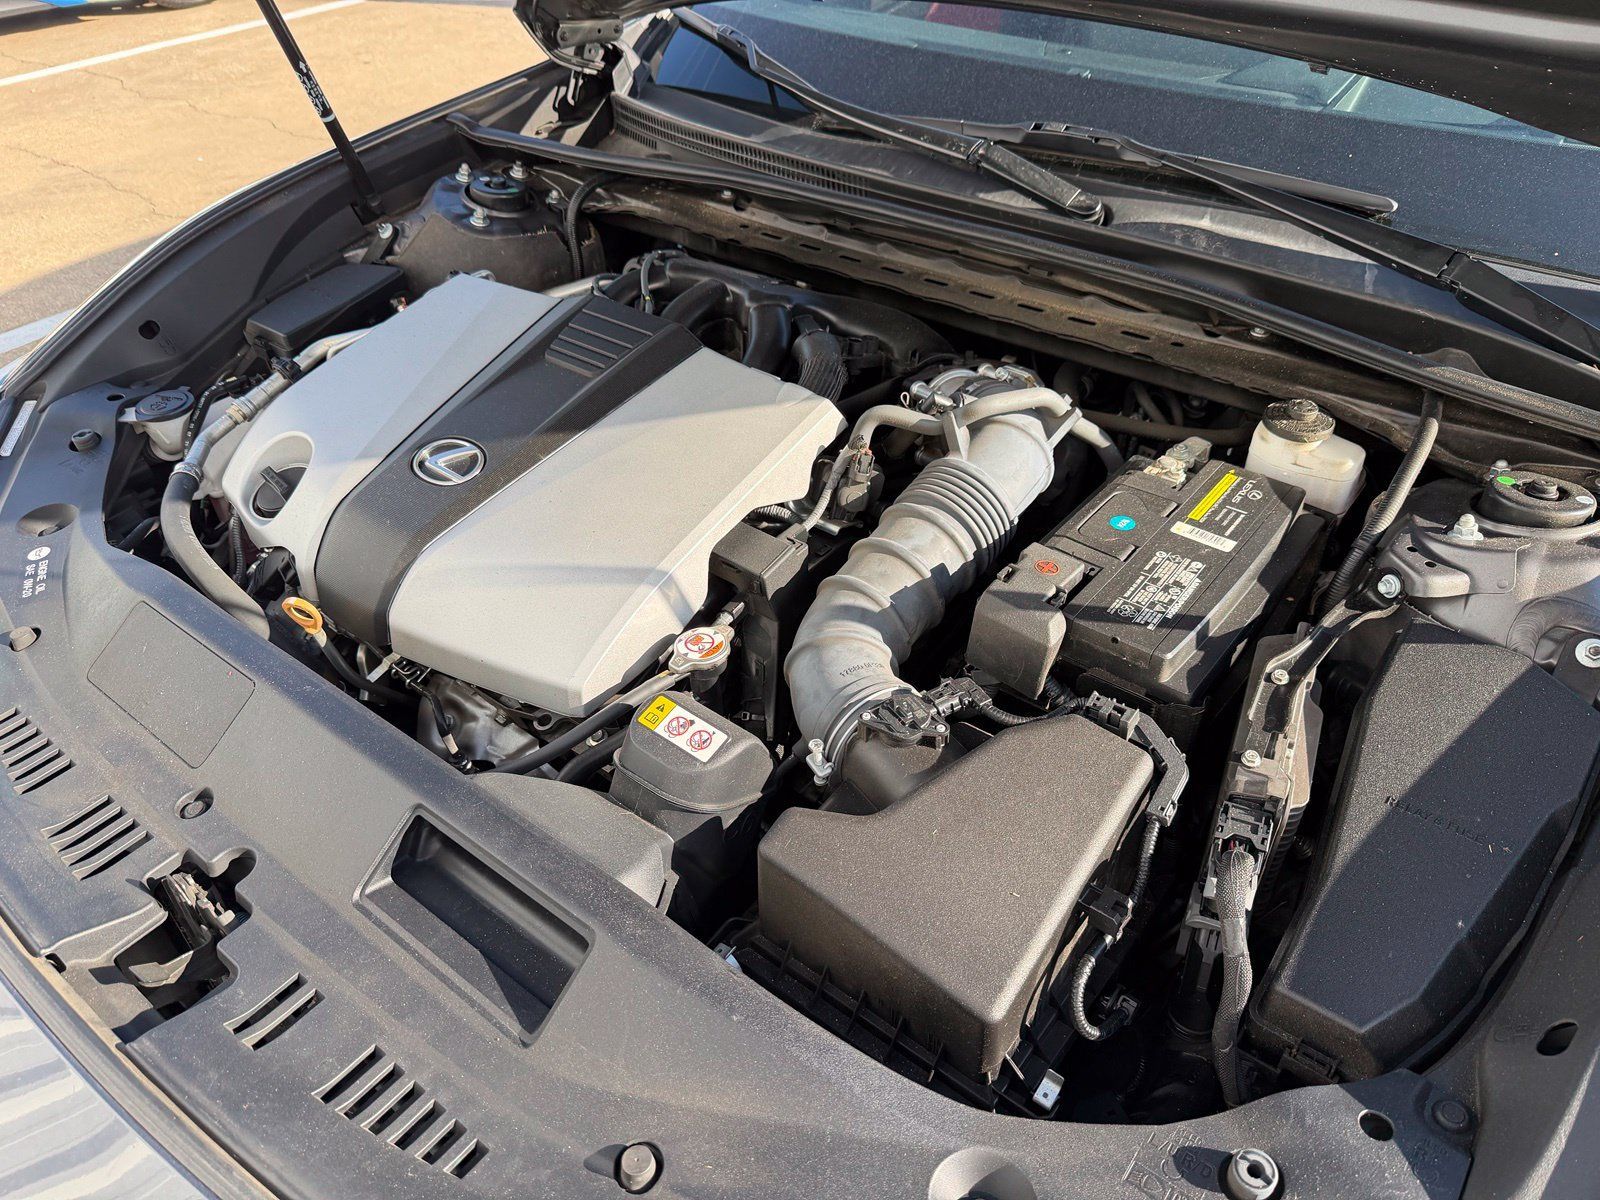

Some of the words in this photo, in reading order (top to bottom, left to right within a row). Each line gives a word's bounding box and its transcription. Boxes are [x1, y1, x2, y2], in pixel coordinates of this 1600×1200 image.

[1232, 480, 1257, 503] LEXUS
[25, 563, 36, 577] SAE
[37, 560, 49, 581] ENGINE
[35, 583, 46, 595] OIL
